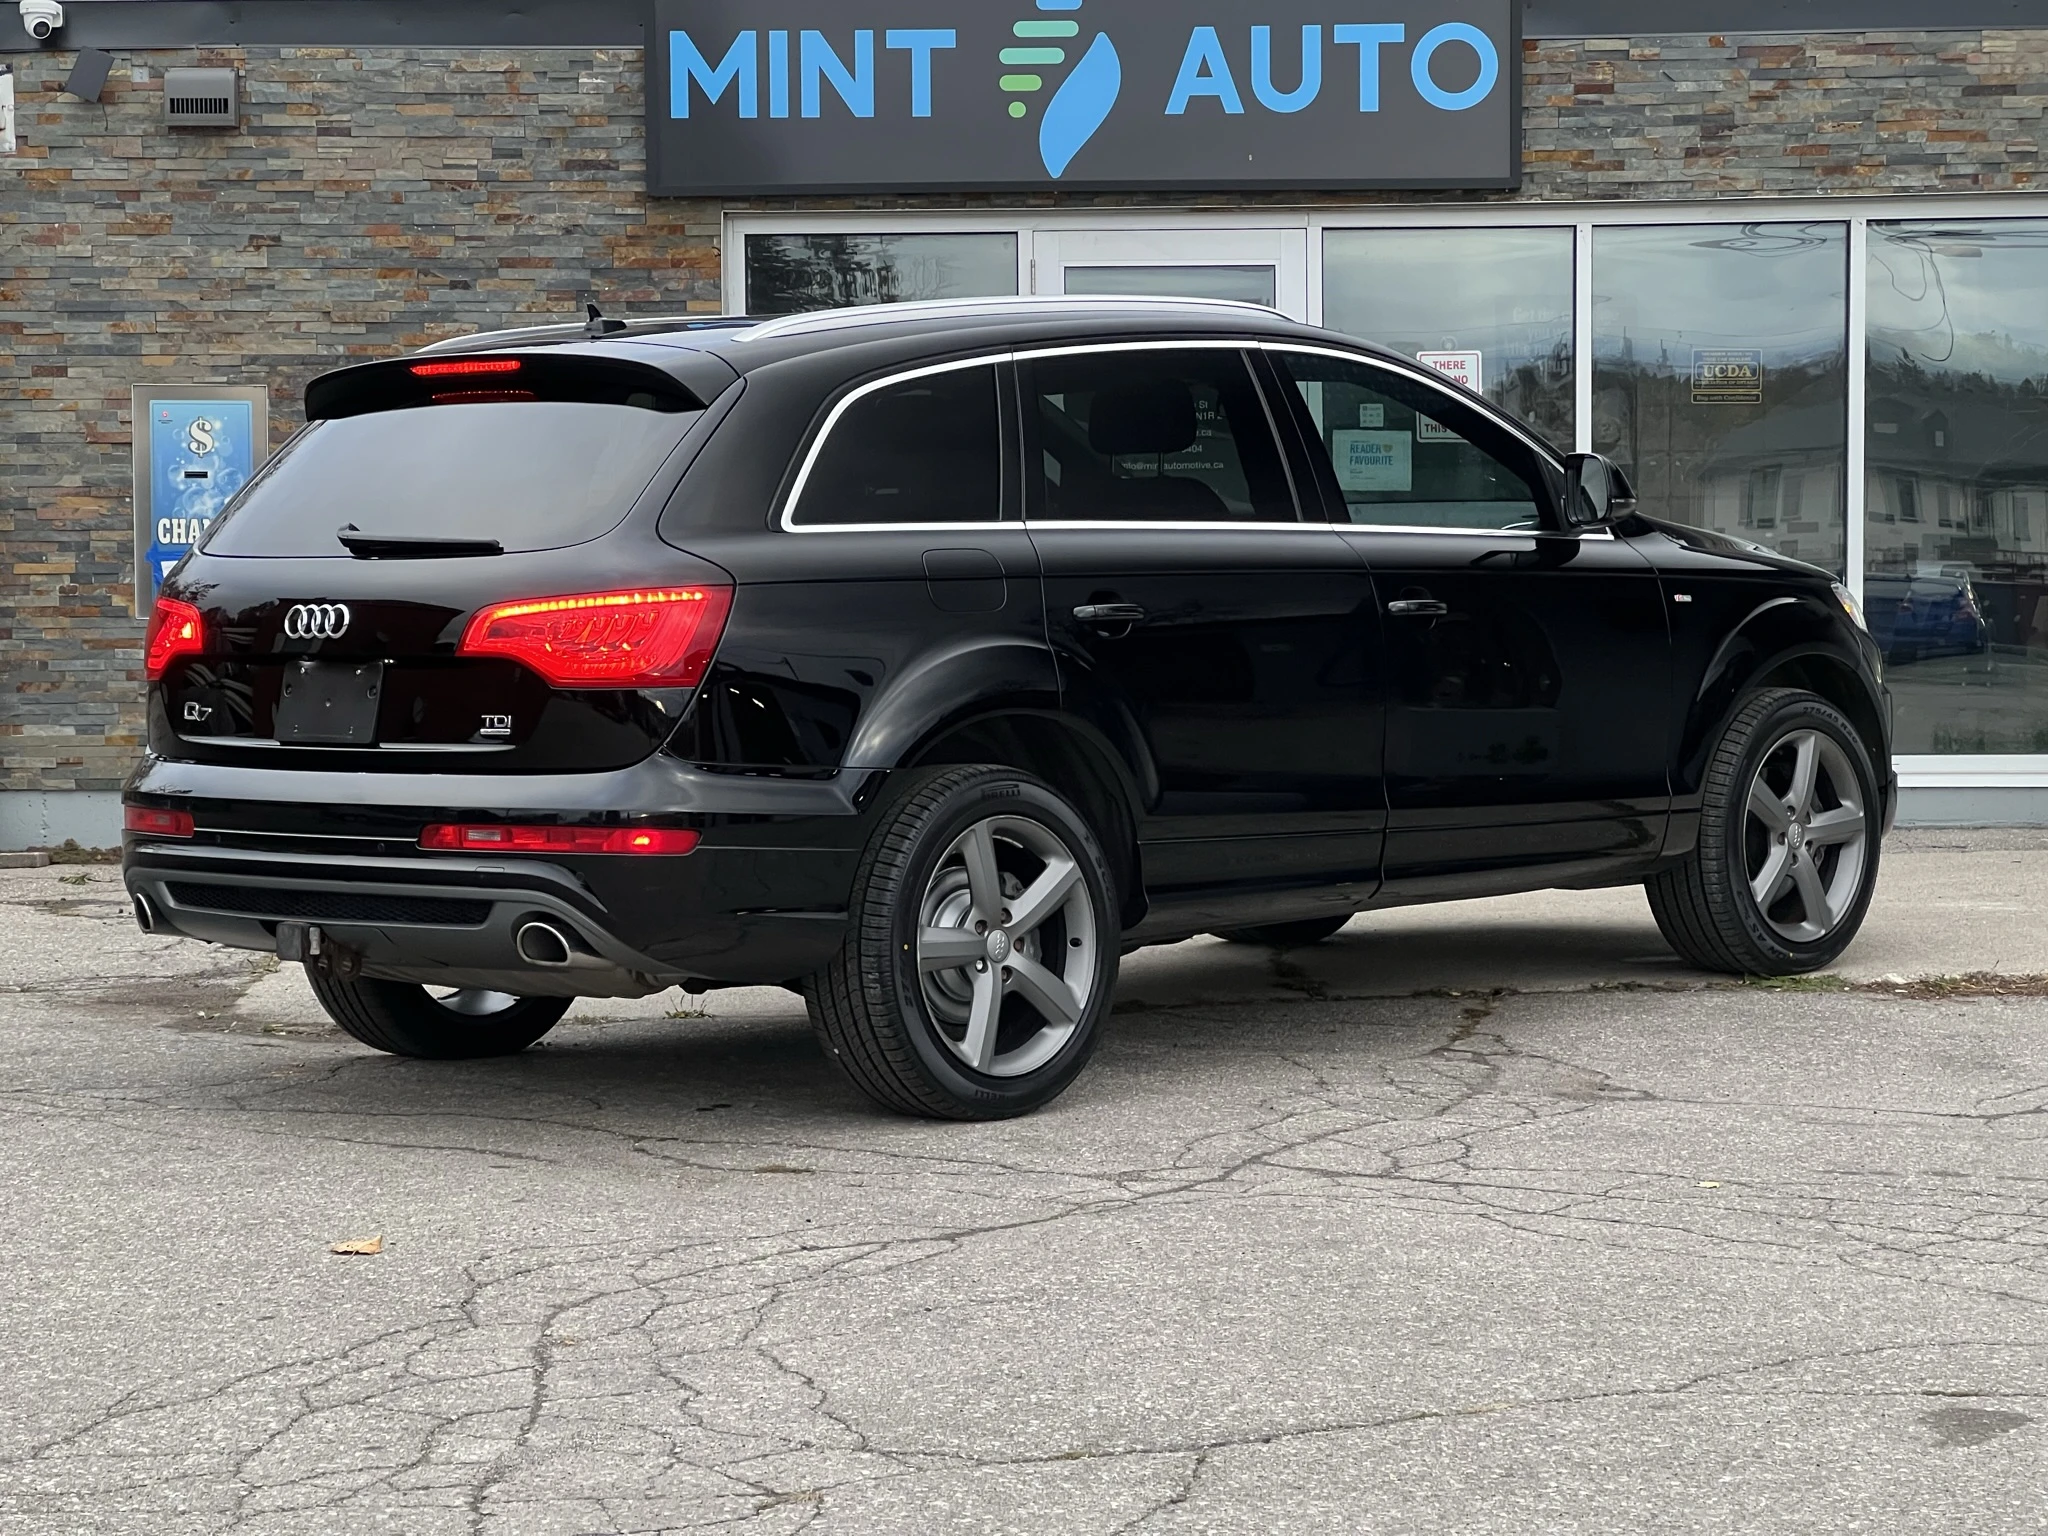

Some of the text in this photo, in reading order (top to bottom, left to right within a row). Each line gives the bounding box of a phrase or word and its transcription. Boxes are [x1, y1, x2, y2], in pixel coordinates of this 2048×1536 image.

[669, 22, 1499, 119] MINT AUTO
[1433, 361, 1466, 370] THERE
[1703, 364, 1752, 378] UCDA
[1425, 423, 1447, 433] THIS
[188, 416, 215, 458] $
[1350, 444, 1382, 454] READER
[1350, 456, 1394, 466] FAVOURITE
[157, 517, 211, 544] CHA
[184, 701, 213, 721] Q7
[481, 715, 512, 727] TDI
